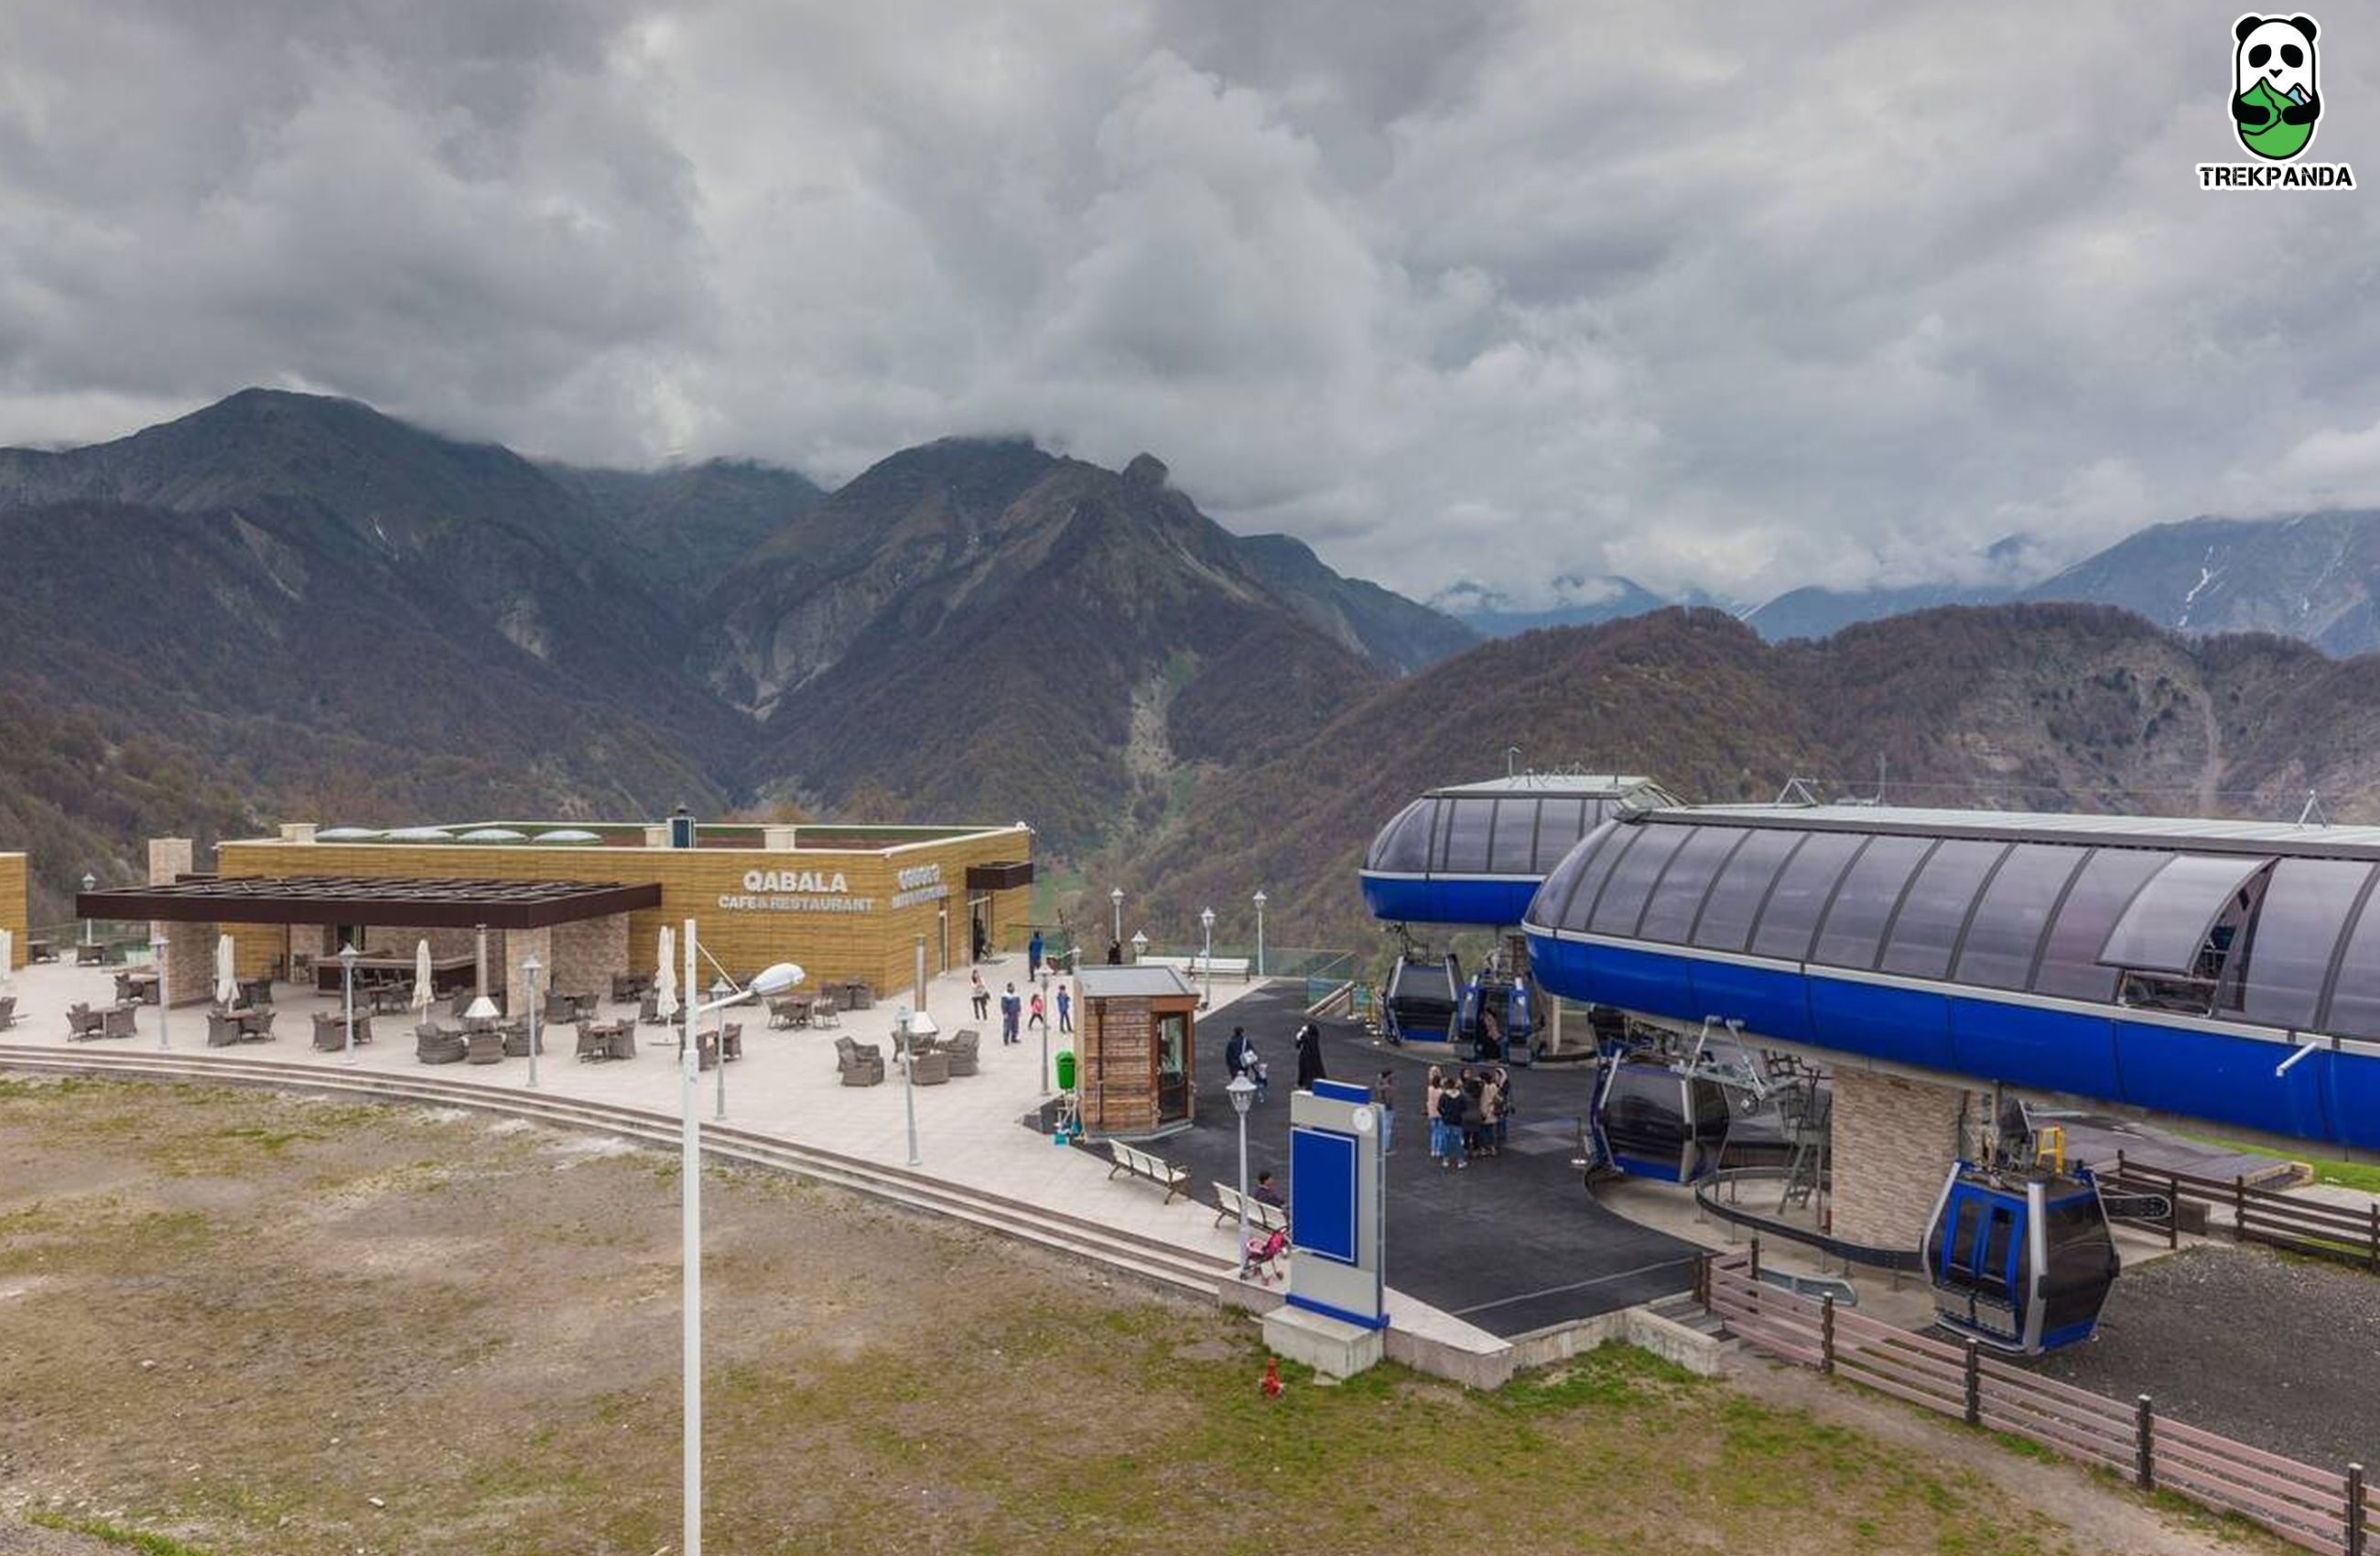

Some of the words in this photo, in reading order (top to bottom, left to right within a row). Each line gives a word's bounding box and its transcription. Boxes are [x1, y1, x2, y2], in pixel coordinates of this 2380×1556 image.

[743, 870, 848, 892] QABALA
[718, 894, 757, 910] CAFE
[771, 896, 874, 912] RESTAURANT
